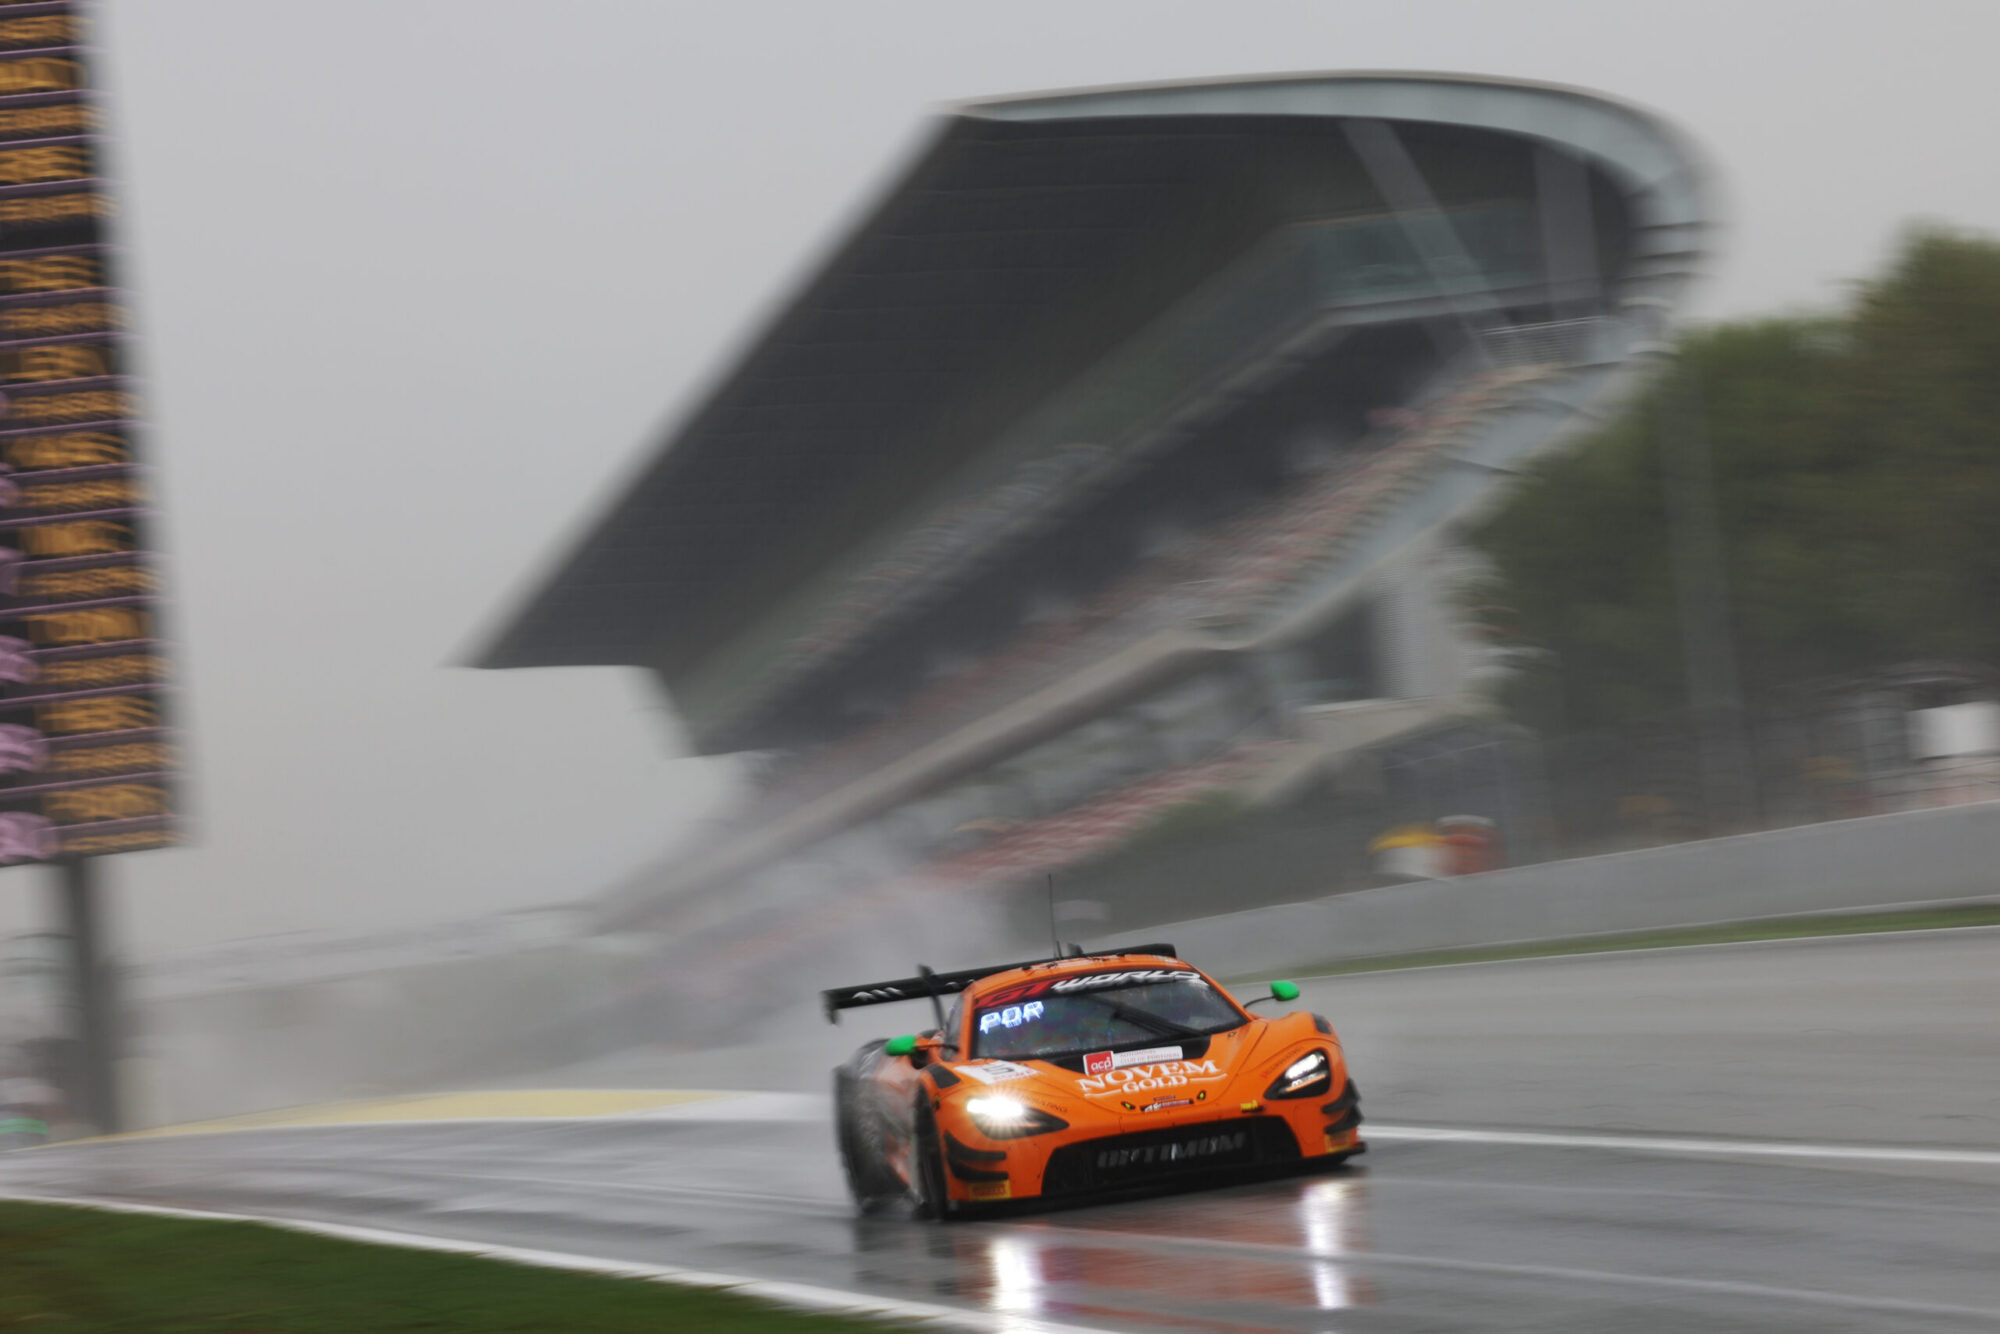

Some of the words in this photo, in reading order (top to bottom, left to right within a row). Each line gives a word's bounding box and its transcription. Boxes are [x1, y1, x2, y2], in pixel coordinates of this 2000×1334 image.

[1051, 969, 1201, 993] WORLD
[979, 1001, 1045, 1034] POR
[1075, 1059, 1220, 1091] NOVEM
[1090, 1056, 1112, 1073] acp
[1121, 1075, 1188, 1093] GOLD
